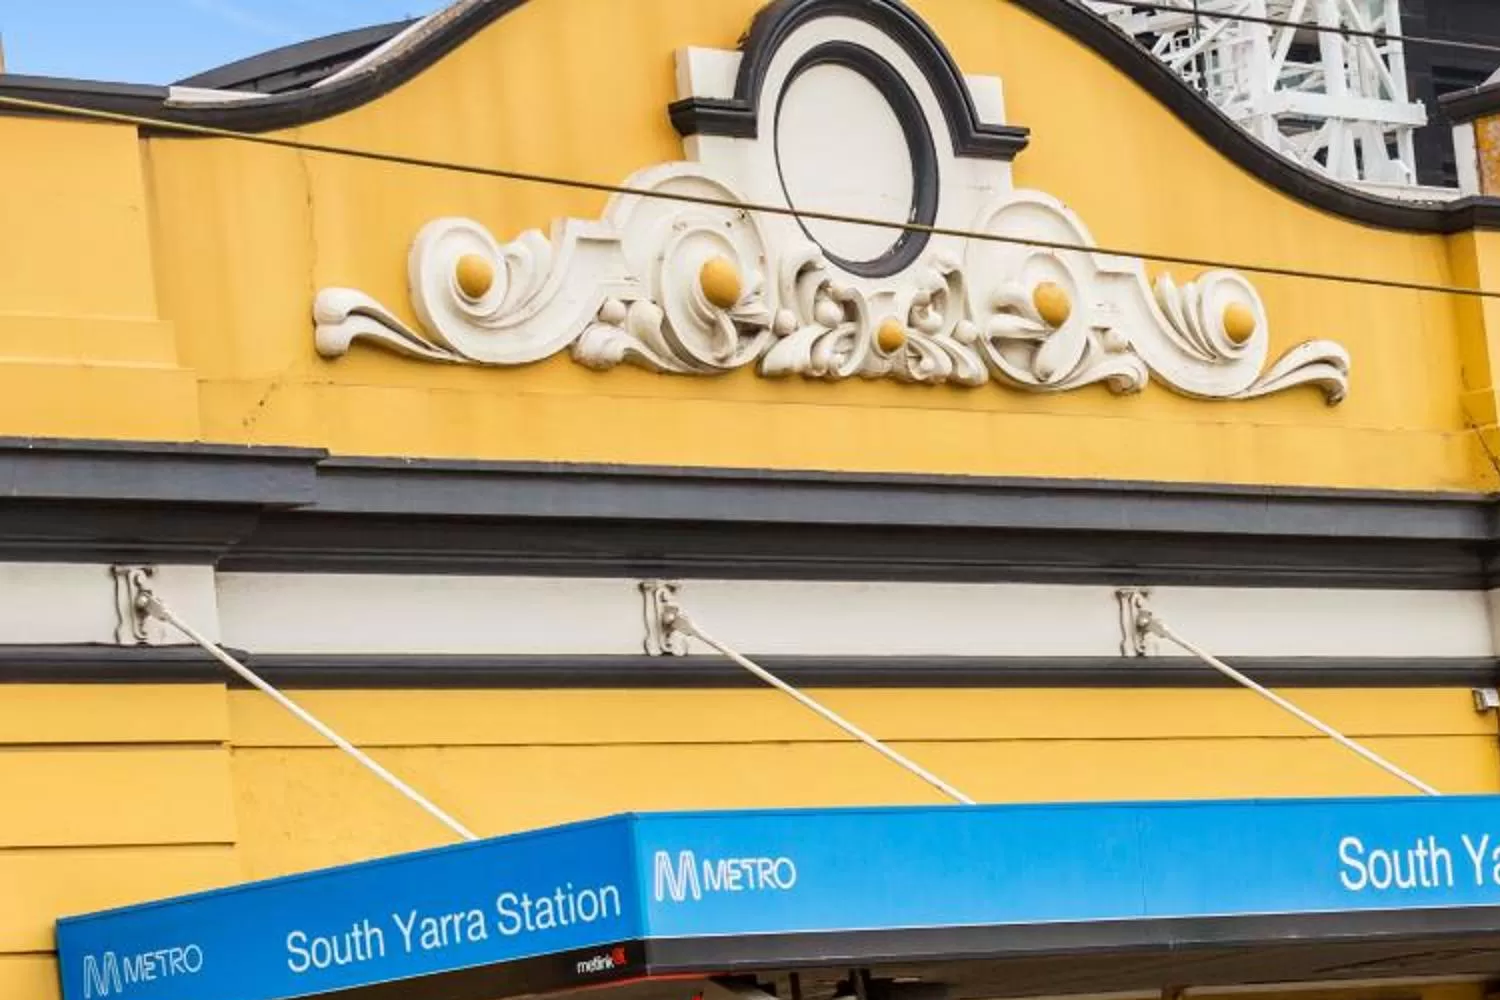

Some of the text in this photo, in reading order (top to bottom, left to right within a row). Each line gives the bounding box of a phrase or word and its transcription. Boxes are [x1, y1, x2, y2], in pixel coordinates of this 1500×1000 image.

[703, 857, 797, 892] METRO
[1339, 834, 1454, 891] South
[286, 882, 622, 974] South Yarra Station
[124, 944, 203, 984] METRO
